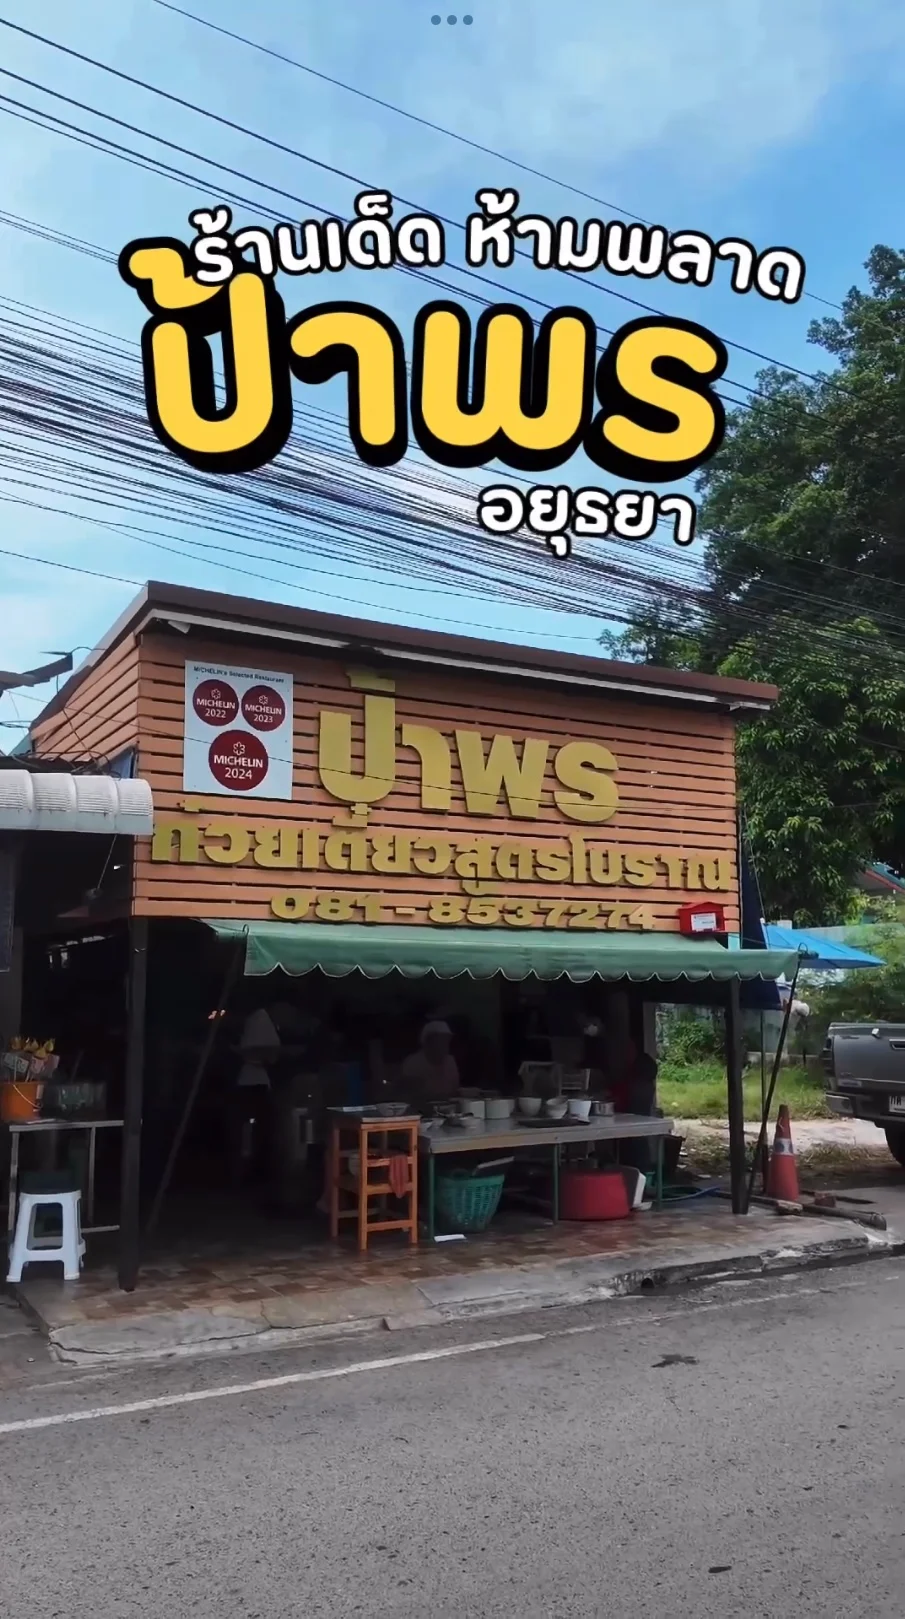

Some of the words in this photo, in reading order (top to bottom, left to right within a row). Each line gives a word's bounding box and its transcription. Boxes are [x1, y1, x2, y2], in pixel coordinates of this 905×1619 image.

[196, 698, 236, 709] MICHELIN
[244, 703, 282, 715] MICHELIN
[204, 708, 226, 719] 2022
[253, 713, 274, 723] 2023
[213, 754, 263, 768] MICHELIN
[224, 767, 252, 779] 2024
[270, 891, 656, 930] 081-8537274
